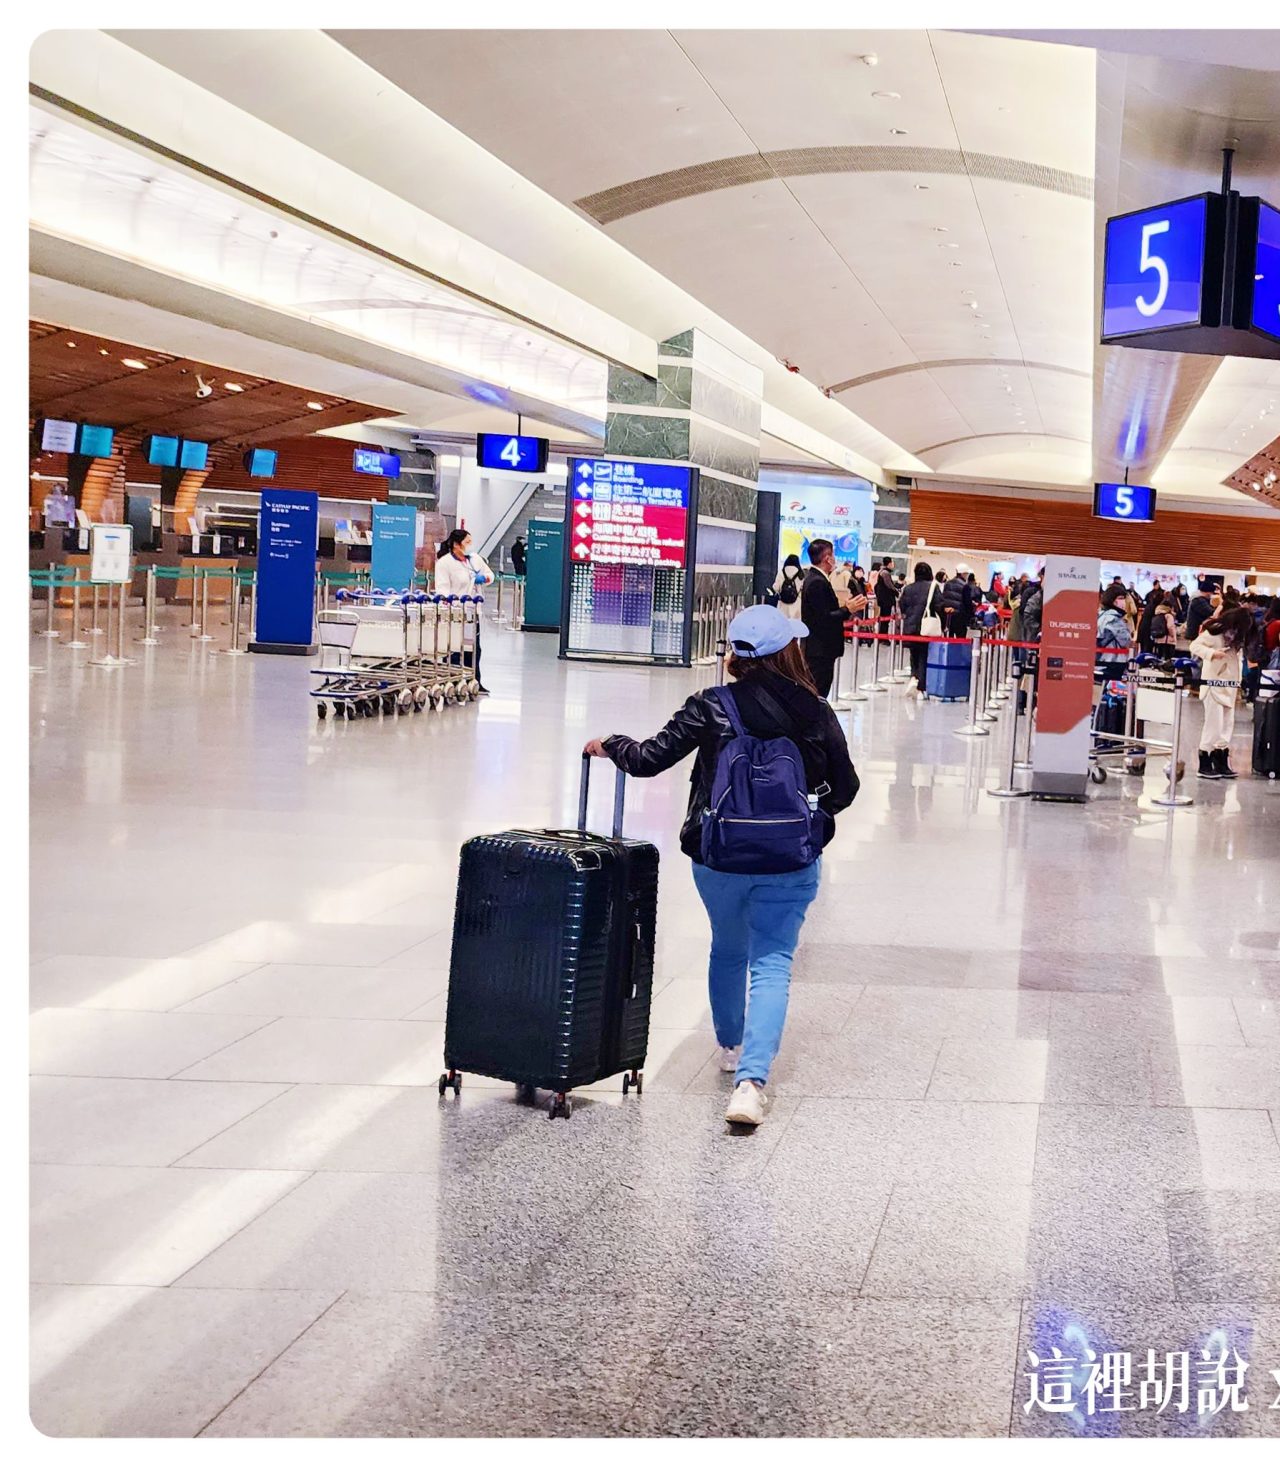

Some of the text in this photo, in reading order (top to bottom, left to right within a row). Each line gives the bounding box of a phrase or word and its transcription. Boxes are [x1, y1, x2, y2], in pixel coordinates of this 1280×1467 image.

[1135, 219, 1170, 317] 5
[500, 437, 521, 467] 4
[1115, 487, 1134, 516] 5
[1049, 621, 1091, 630] BUSINESS
[1121, 674, 1157, 683] STARLUX
[1206, 680, 1242, 688] STARLUX
